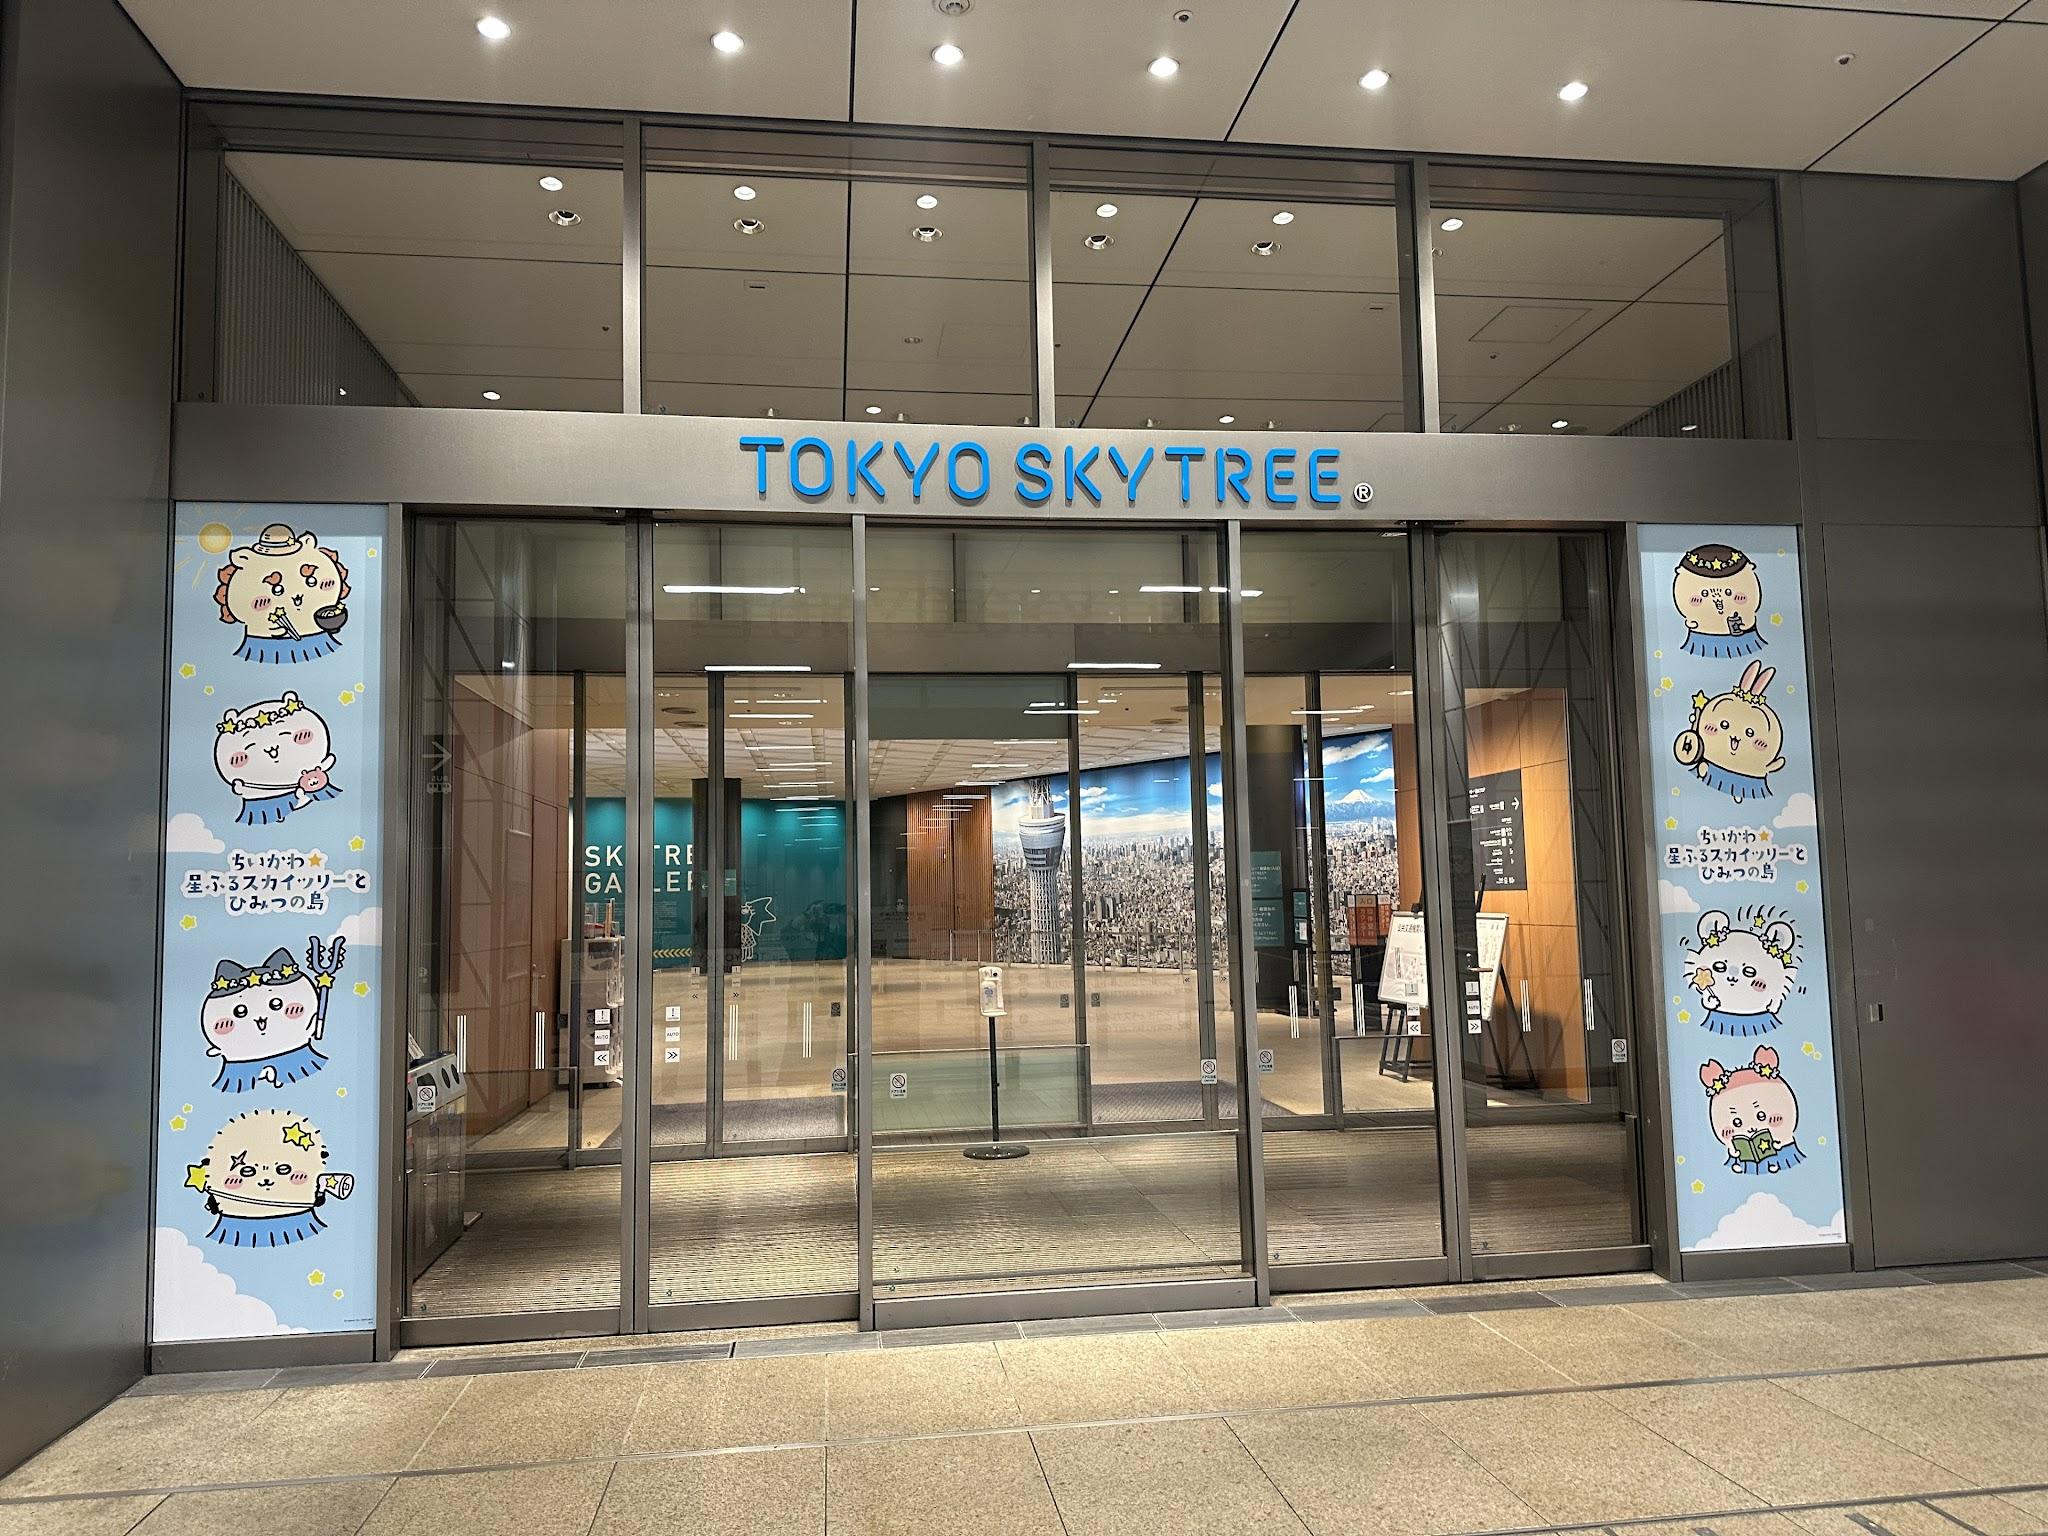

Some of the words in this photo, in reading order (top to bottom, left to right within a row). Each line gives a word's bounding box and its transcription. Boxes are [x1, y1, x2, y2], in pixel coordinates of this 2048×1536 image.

[739, 436, 991, 500] TOKYO
[1701, 862, 1775, 881] ひみつの島
[229, 890, 325, 912] ひみつの島
